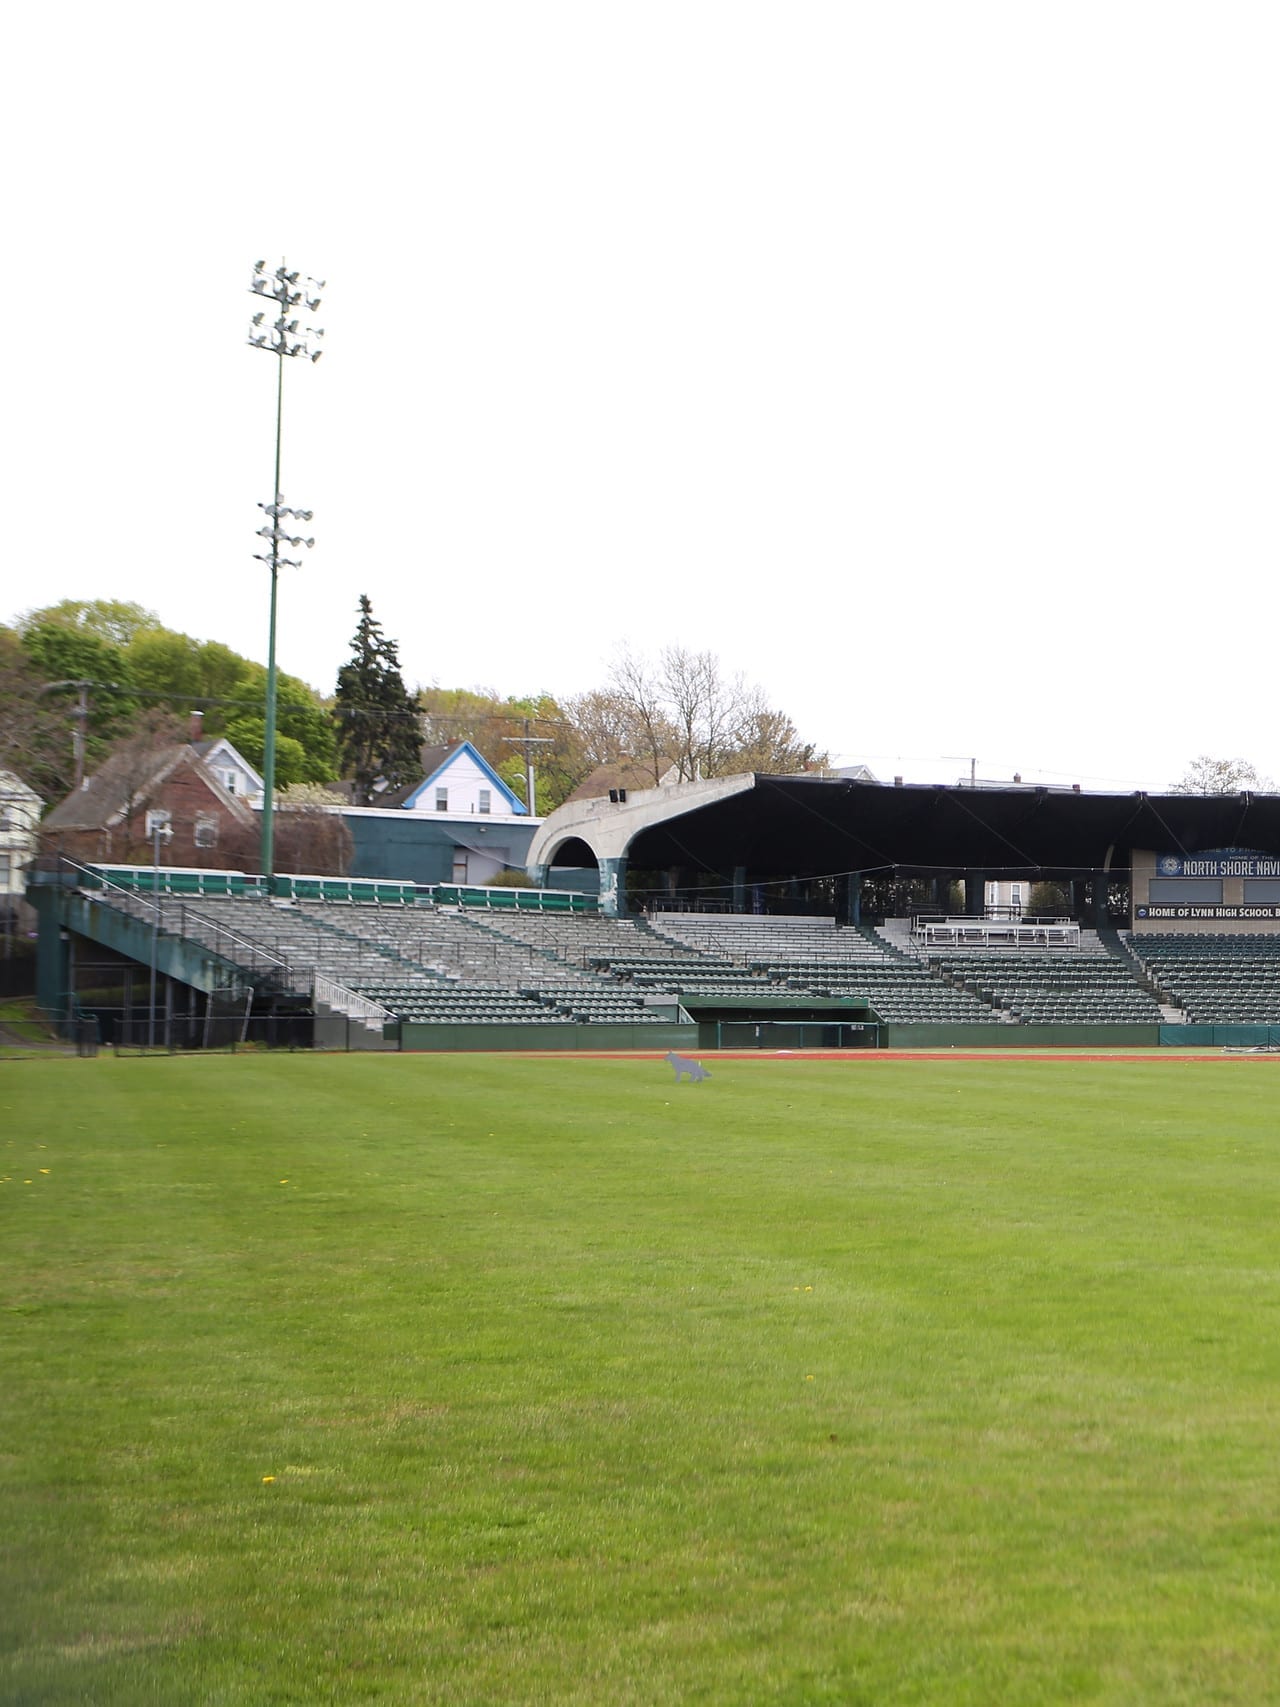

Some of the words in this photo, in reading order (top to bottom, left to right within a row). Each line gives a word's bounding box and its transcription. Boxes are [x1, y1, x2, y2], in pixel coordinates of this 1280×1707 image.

[1183, 860, 1217, 876] NORTH
[1220, 860, 1254, 876] SHORE
[1149, 908, 1175, 917] HOME
[1178, 908, 1189, 917] OF
[1191, 908, 1214, 917] LYNN
[1215, 908, 1238, 917] HIGH
[1239, 908, 1272, 917] SCHOOL
